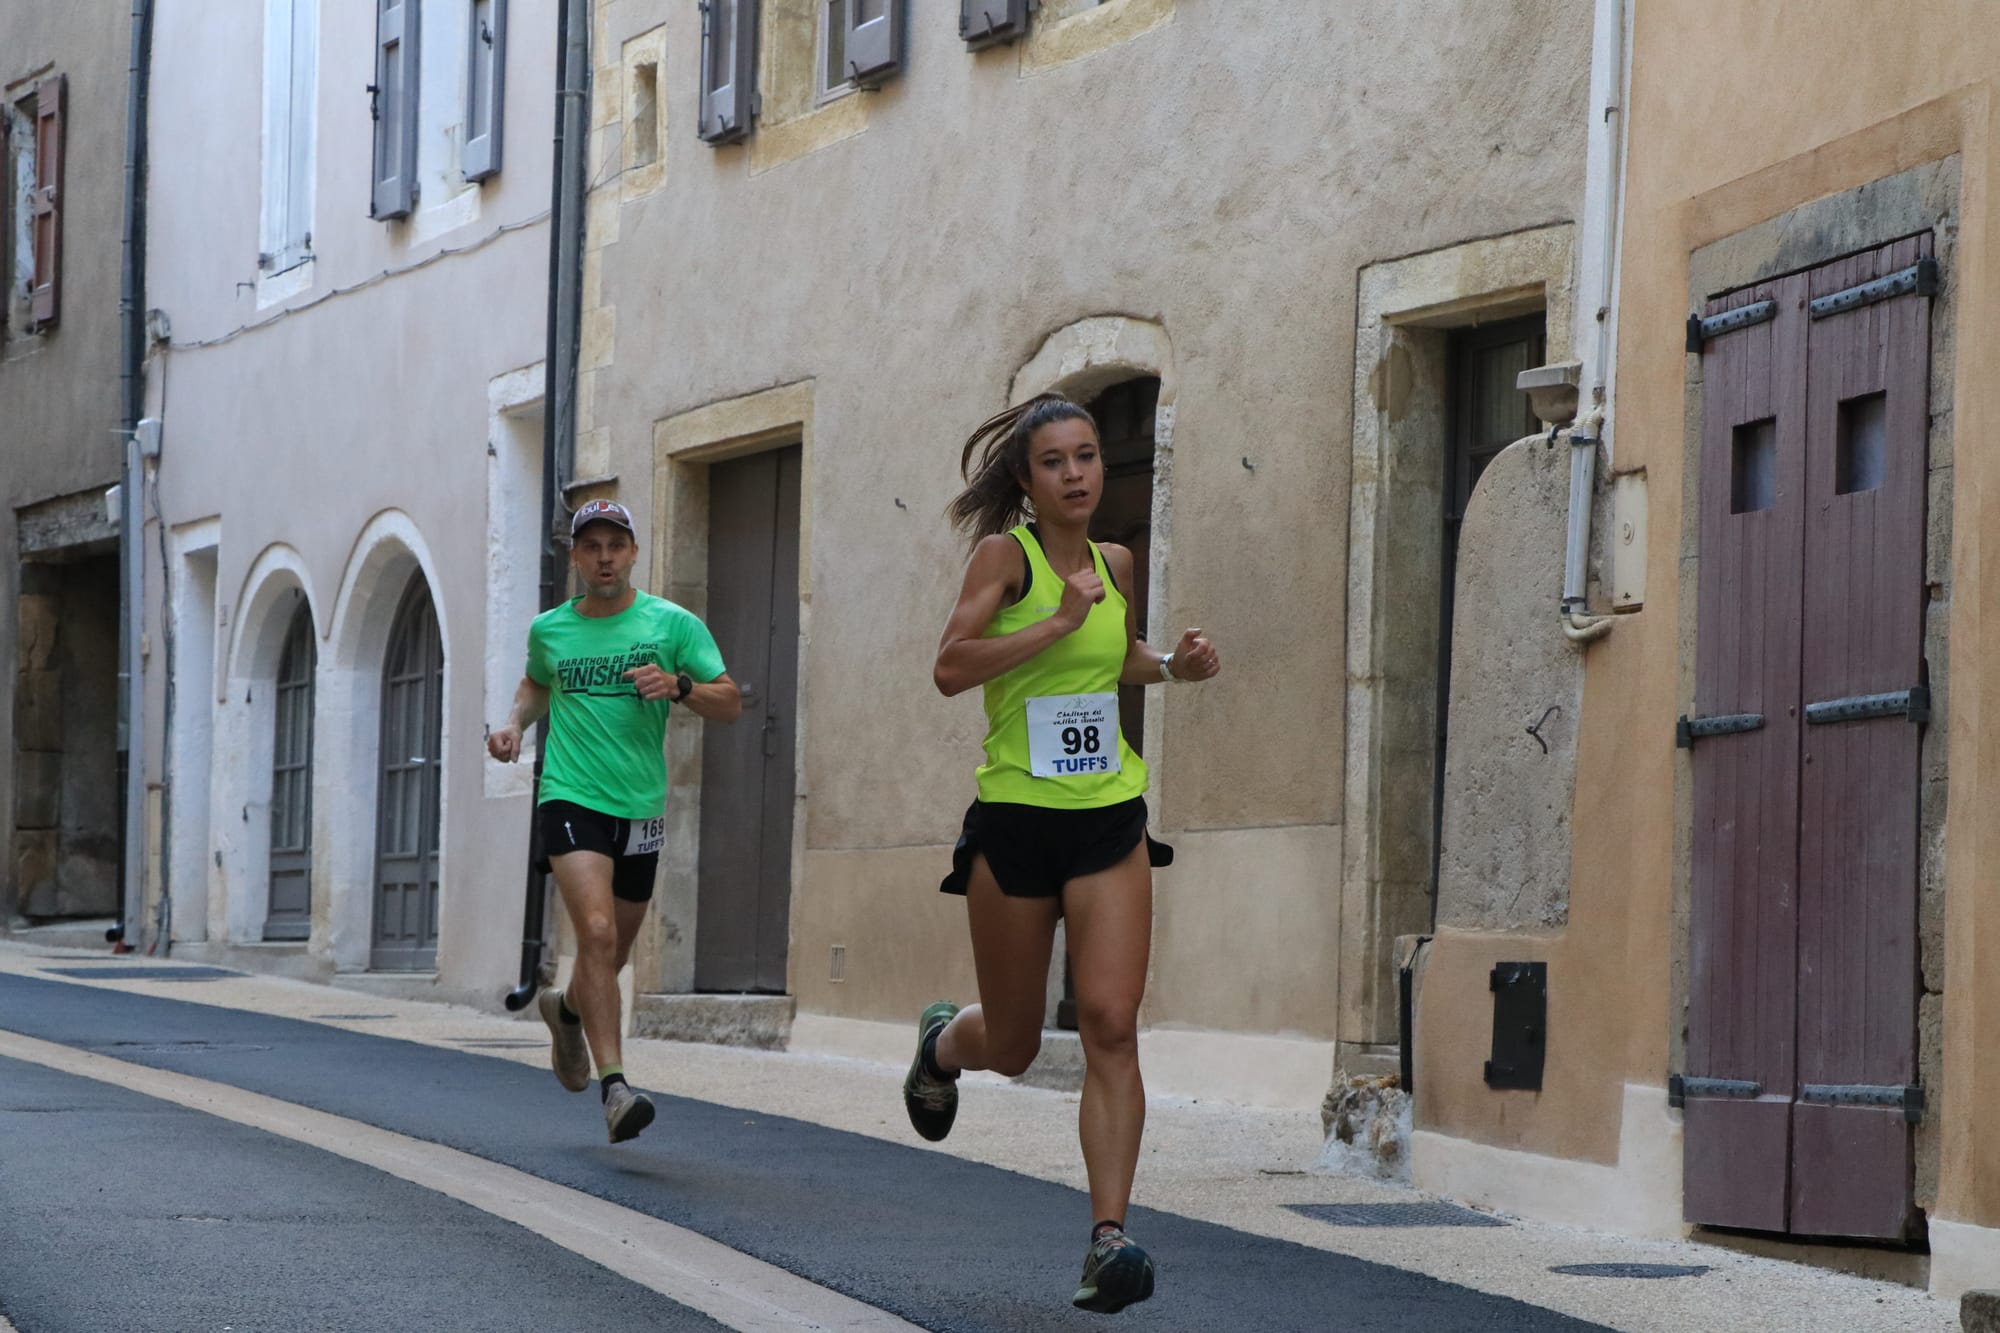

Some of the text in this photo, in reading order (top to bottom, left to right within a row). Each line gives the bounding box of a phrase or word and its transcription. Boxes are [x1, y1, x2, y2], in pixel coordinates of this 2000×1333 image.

[557, 652, 657, 668] MARATHON DE PARIS
[557, 663, 648, 689] FINISHE
[1061, 725, 1100, 755] 98
[1052, 756, 1108, 773] TUFF'S
[642, 818, 664, 840] 169
